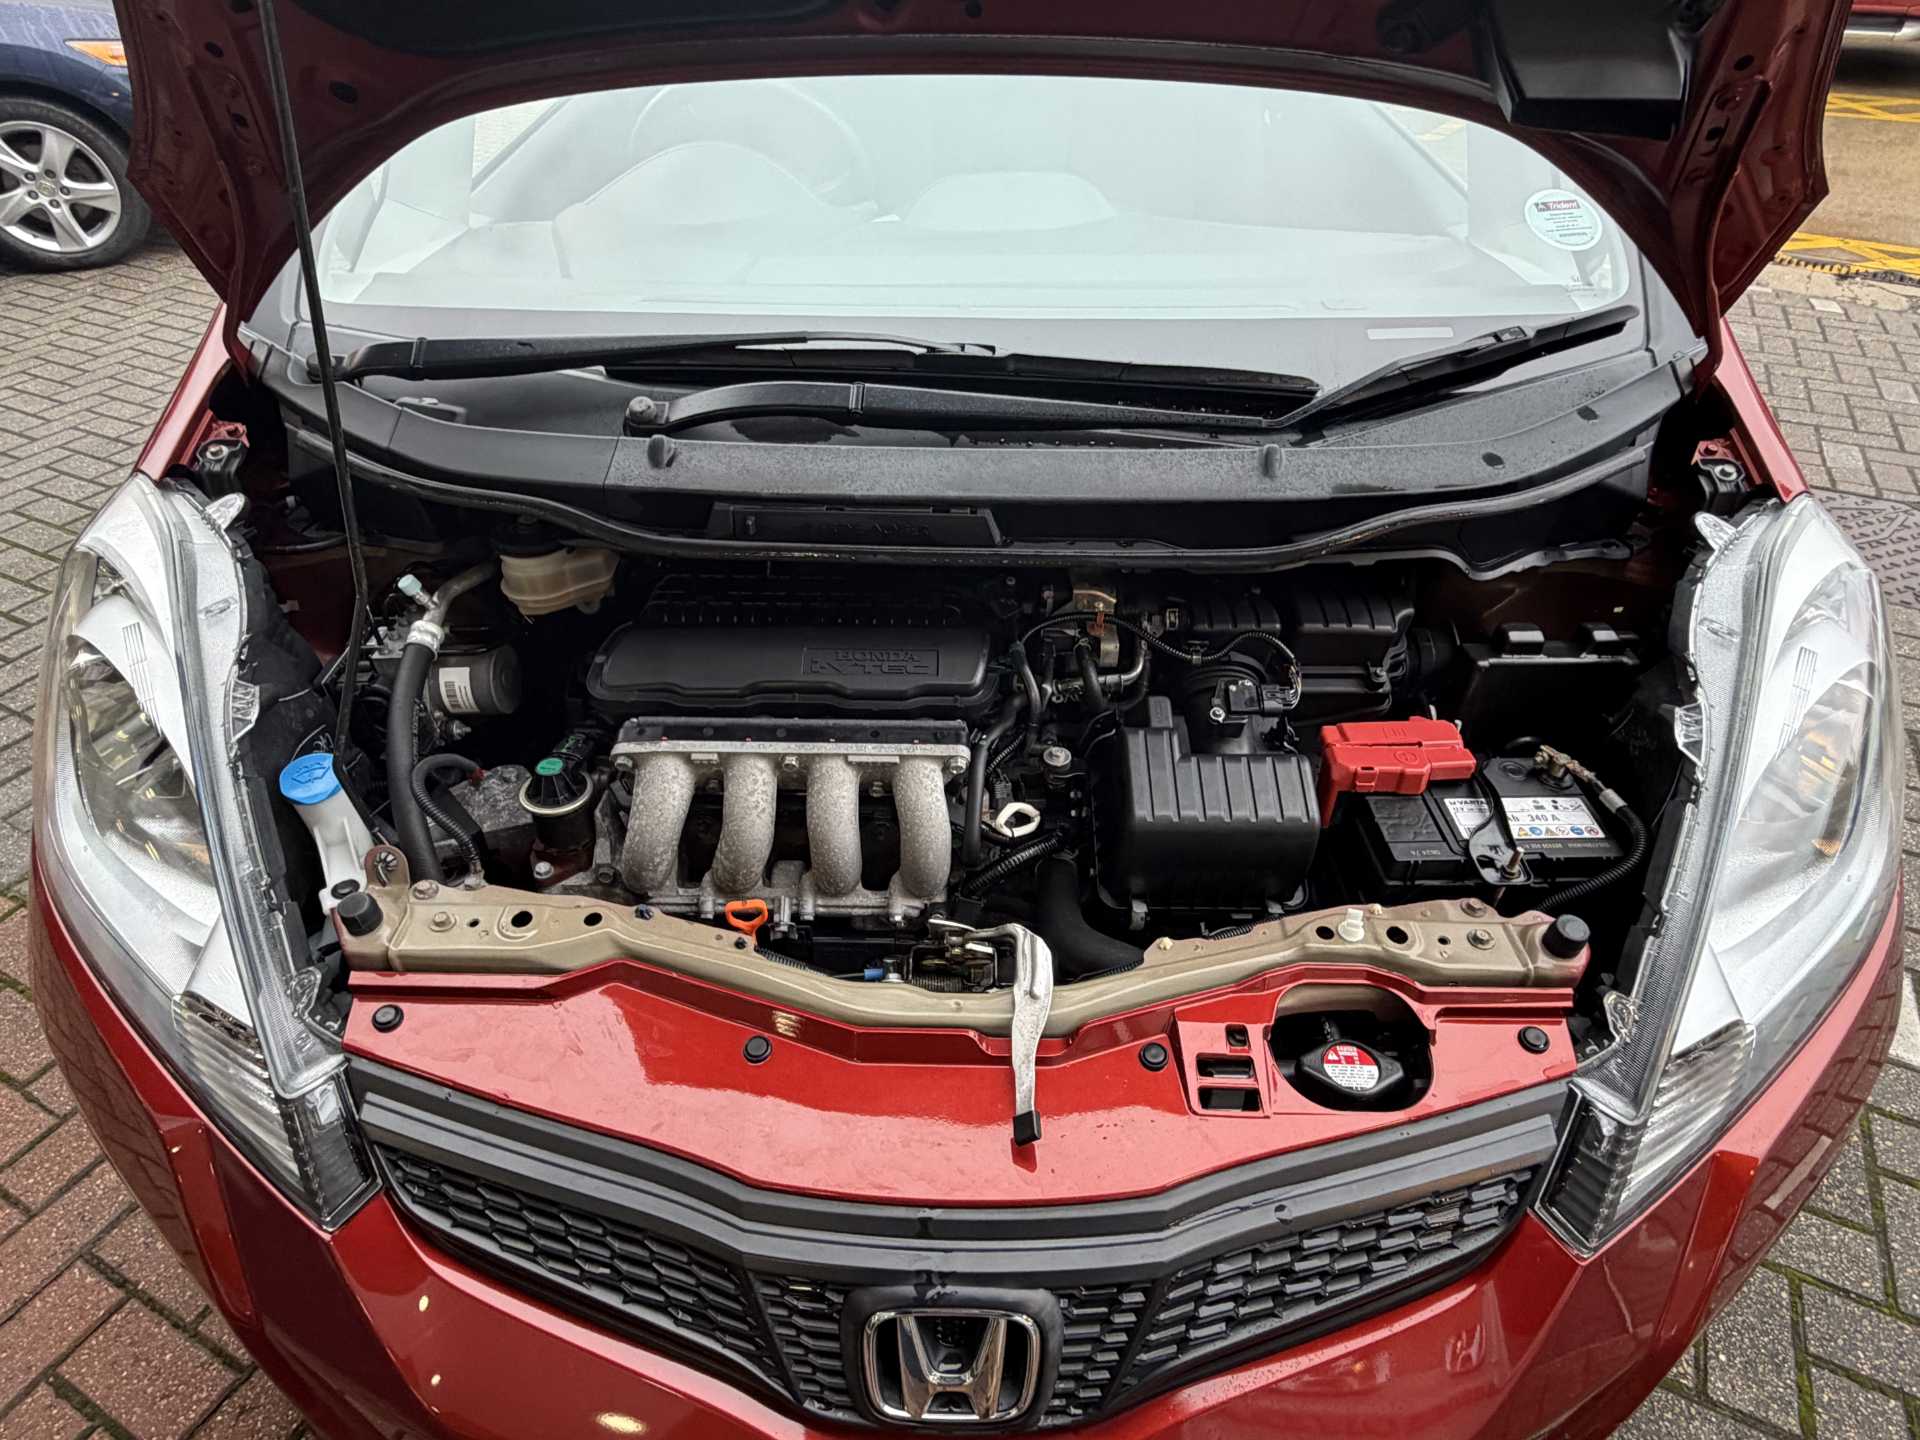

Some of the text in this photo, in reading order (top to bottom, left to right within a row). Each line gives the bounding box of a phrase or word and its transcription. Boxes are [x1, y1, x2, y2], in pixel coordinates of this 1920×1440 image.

[1550, 201, 1577, 210] Trident
[835, 649, 920, 663] HONDA
[1528, 813, 1549, 822] 340
